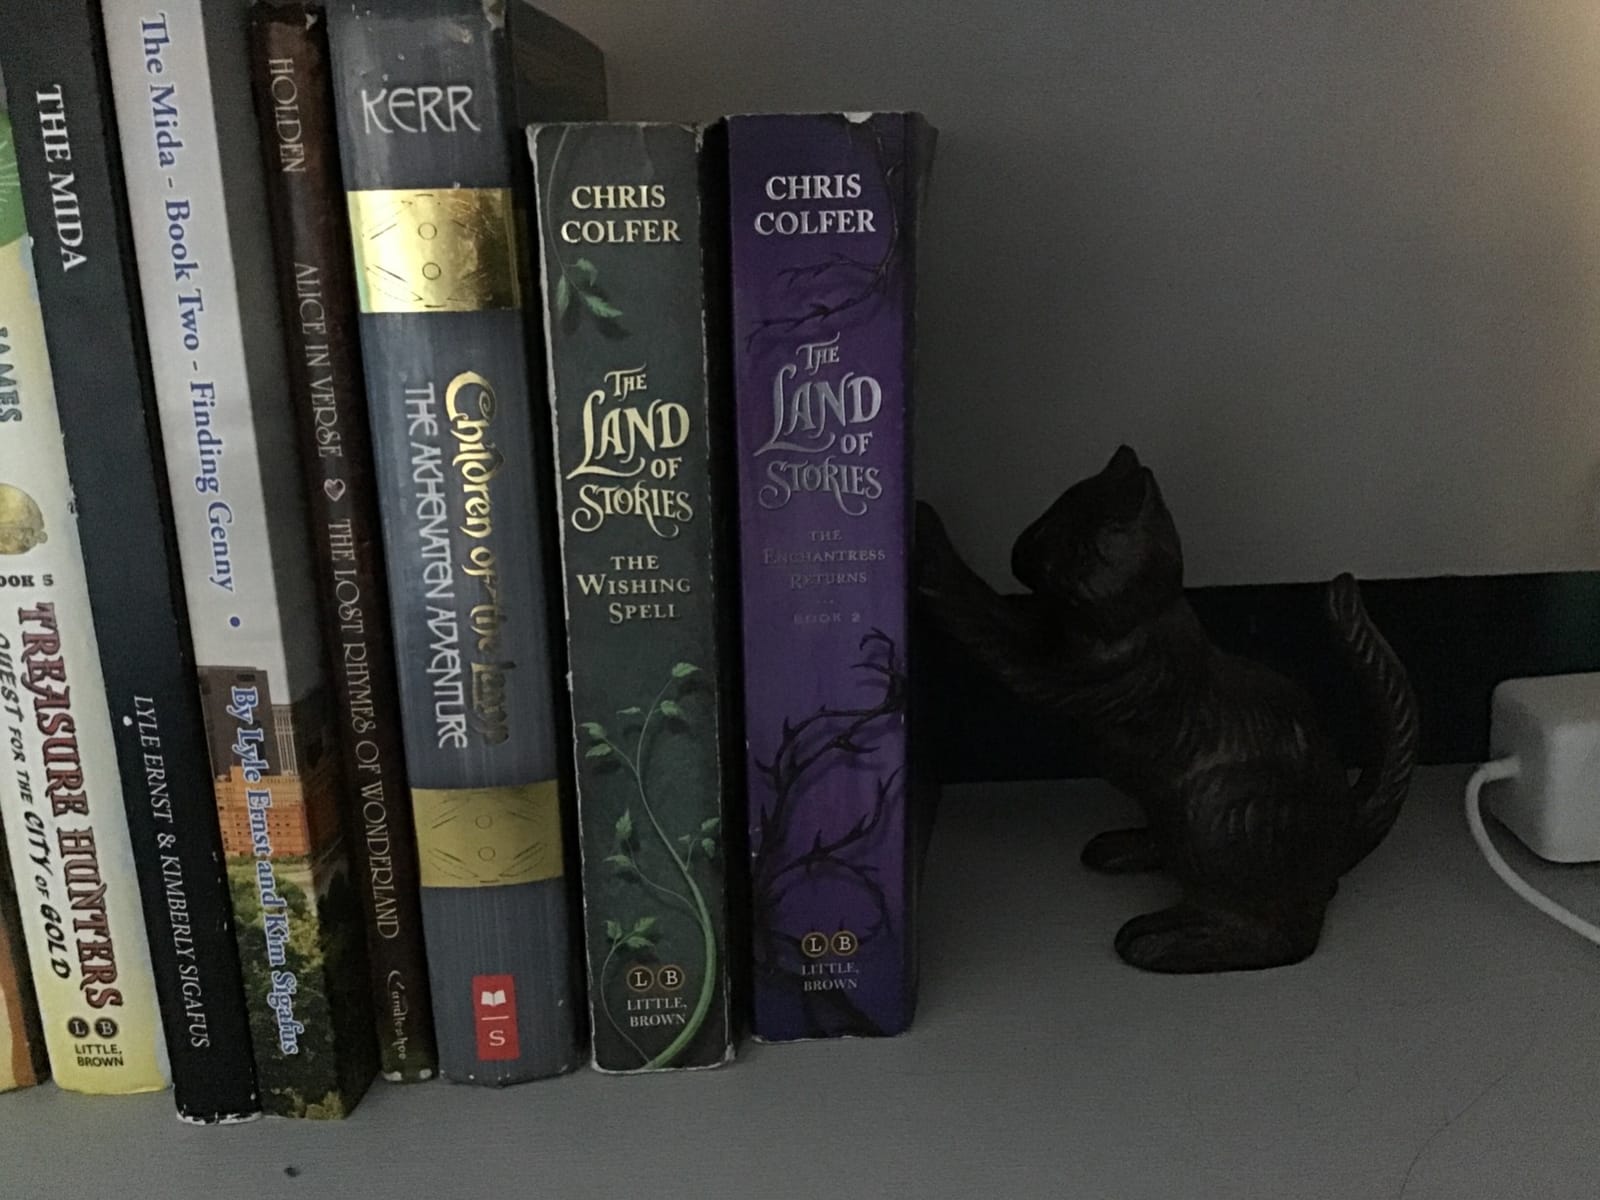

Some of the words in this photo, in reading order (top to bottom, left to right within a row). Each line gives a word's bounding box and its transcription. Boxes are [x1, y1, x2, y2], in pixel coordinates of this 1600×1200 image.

[141, 13, 170, 73] The
[36, 84, 72, 163] THE
[150, 84, 183, 168] Mida
[268, 57, 306, 173] HOLDEN
[361, 85, 481, 135] KERR
[571, 184, 666, 209] CHRIS
[765, 173, 862, 201] CHRIS
[48, 171, 87, 272] MIDA
[165, 200, 199, 281] Book
[560, 219, 681, 244] COLFER
[754, 209, 876, 236] COLFER
[178, 288, 204, 351] Two
[294, 262, 327, 335] ALICE
[304, 344, 331, 367] IN
[190, 382, 223, 493] Finding
[310, 376, 343, 458] VERSE
[405, 382, 439, 436] THE
[566, 390, 690, 480] LAND
[753, 364, 882, 457] LAND
[445, 370, 505, 539] Children
[651, 457, 682, 479] OF
[841, 432, 872, 456] OF
[571, 480, 694, 538] STORIES
[759, 455, 883, 516] STORIES
[208, 502, 233, 592] Genny
[328, 518, 356, 561] THE
[410, 441, 455, 598] AKHENATEN
[809, 530, 842, 542] THE
[0, 575, 35, 588] OOK
[43, 574, 54, 586] 5
[576, 574, 691, 596] WISHING
[610, 555, 660, 571] THE
[333, 569, 364, 633] LOST
[608, 602, 677, 624] SPELL
[226, 686, 259, 724] By
[343, 642, 376, 734] RHYMES
[425, 605, 468, 749] ADVENTURE
[9, 725, 26, 762] FOR
[134, 695, 160, 748] LYLE
[233, 727, 269, 784] Lyle
[356, 740, 382, 775] OF
[16, 766, 33, 804] THE
[18, 601, 89, 817] TREASURE
[57, 827, 123, 1009] HUNTERS
[143, 753, 173, 824] ERNST
[24, 810, 53, 876] CITY
[157, 832, 177, 849] &
[246, 788, 272, 857] Ernst
[35, 874, 50, 900] OF
[256, 860, 287, 908] and
[360, 780, 400, 939] WONDERLAND
[160, 854, 196, 961] KIMBERLY
[40, 902, 71, 980] GOLD
[264, 912, 290, 967] Kim
[178, 964, 210, 1048] SIGAFUS
[267, 970, 304, 1055] Sigafus
[803, 979, 857, 992] BROWN
[74, 1043, 123, 1055] LITTLE,
[489, 1029, 506, 1047] S
[630, 1013, 686, 1028] BROWN
[77, 1056, 124, 1067] BROWN
